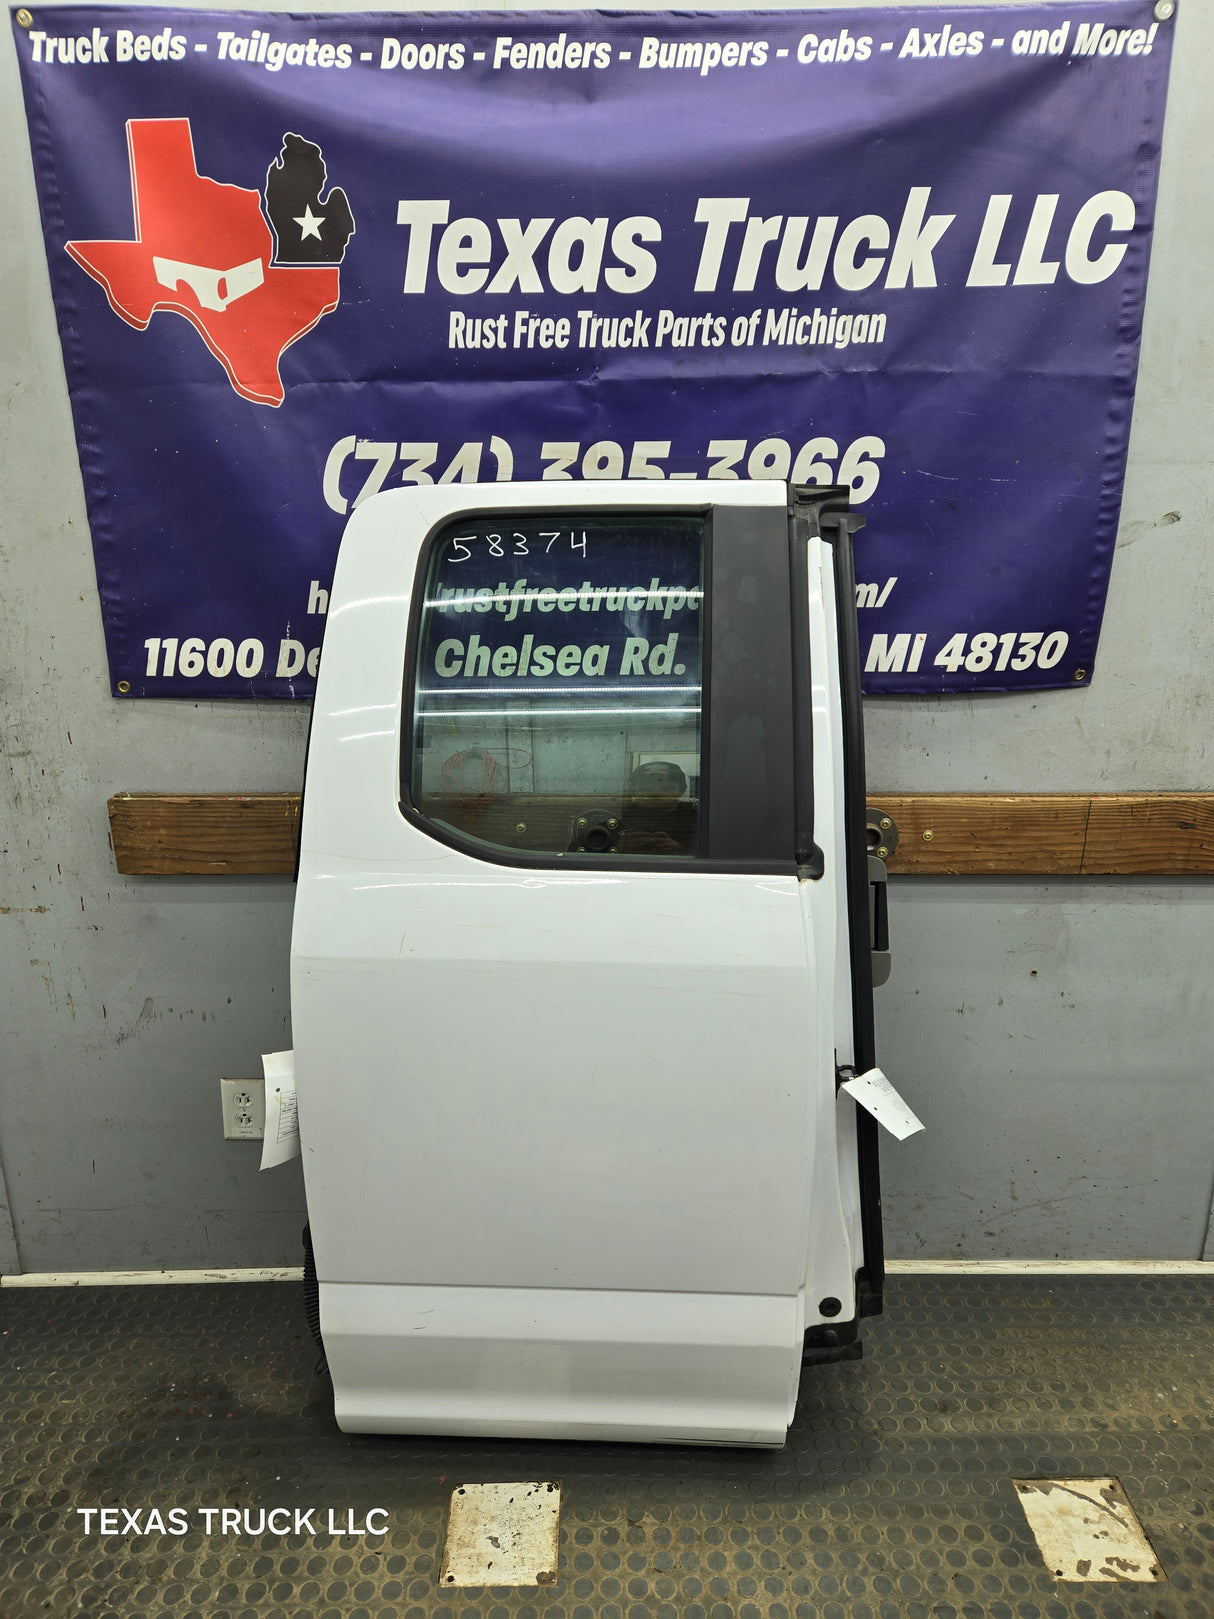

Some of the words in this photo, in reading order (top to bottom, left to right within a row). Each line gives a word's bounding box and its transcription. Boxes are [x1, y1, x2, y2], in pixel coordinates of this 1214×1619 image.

[29, 28, 110, 64] Truck
[116, 27, 188, 62] Beds
[216, 30, 353, 72] Tailgates
[380, 37, 466, 70] Doors
[492, 33, 612, 69] Fenders
[638, 37, 770, 76] Bumpers
[796, 29, 874, 64] Cabs
[898, 24, 985, 59] Axles
[1011, 21, 1072, 55] and
[1072, 22, 1160, 56] More!
[397, 199, 662, 295] Texas
[694, 187, 957, 292] Truck
[966, 190, 1136, 287] LLC
[448, 310, 509, 349] Rust
[513, 310, 571, 349] Free
[577, 309, 652, 349] Truck
[655, 310, 728, 348] Parts
[731, 308, 762, 347] of
[762, 307, 887, 350] Michigan
[323, 435, 514, 515] (734)
[447, 531, 588, 562] 58374
[144, 637, 264, 678] 11600
[275, 638, 322, 678] De
[434, 634, 610, 678] Chelsea
[619, 632, 687, 676] Rd.
[864, 633, 928, 673] MI
[933, 630, 1069, 673] 48130
